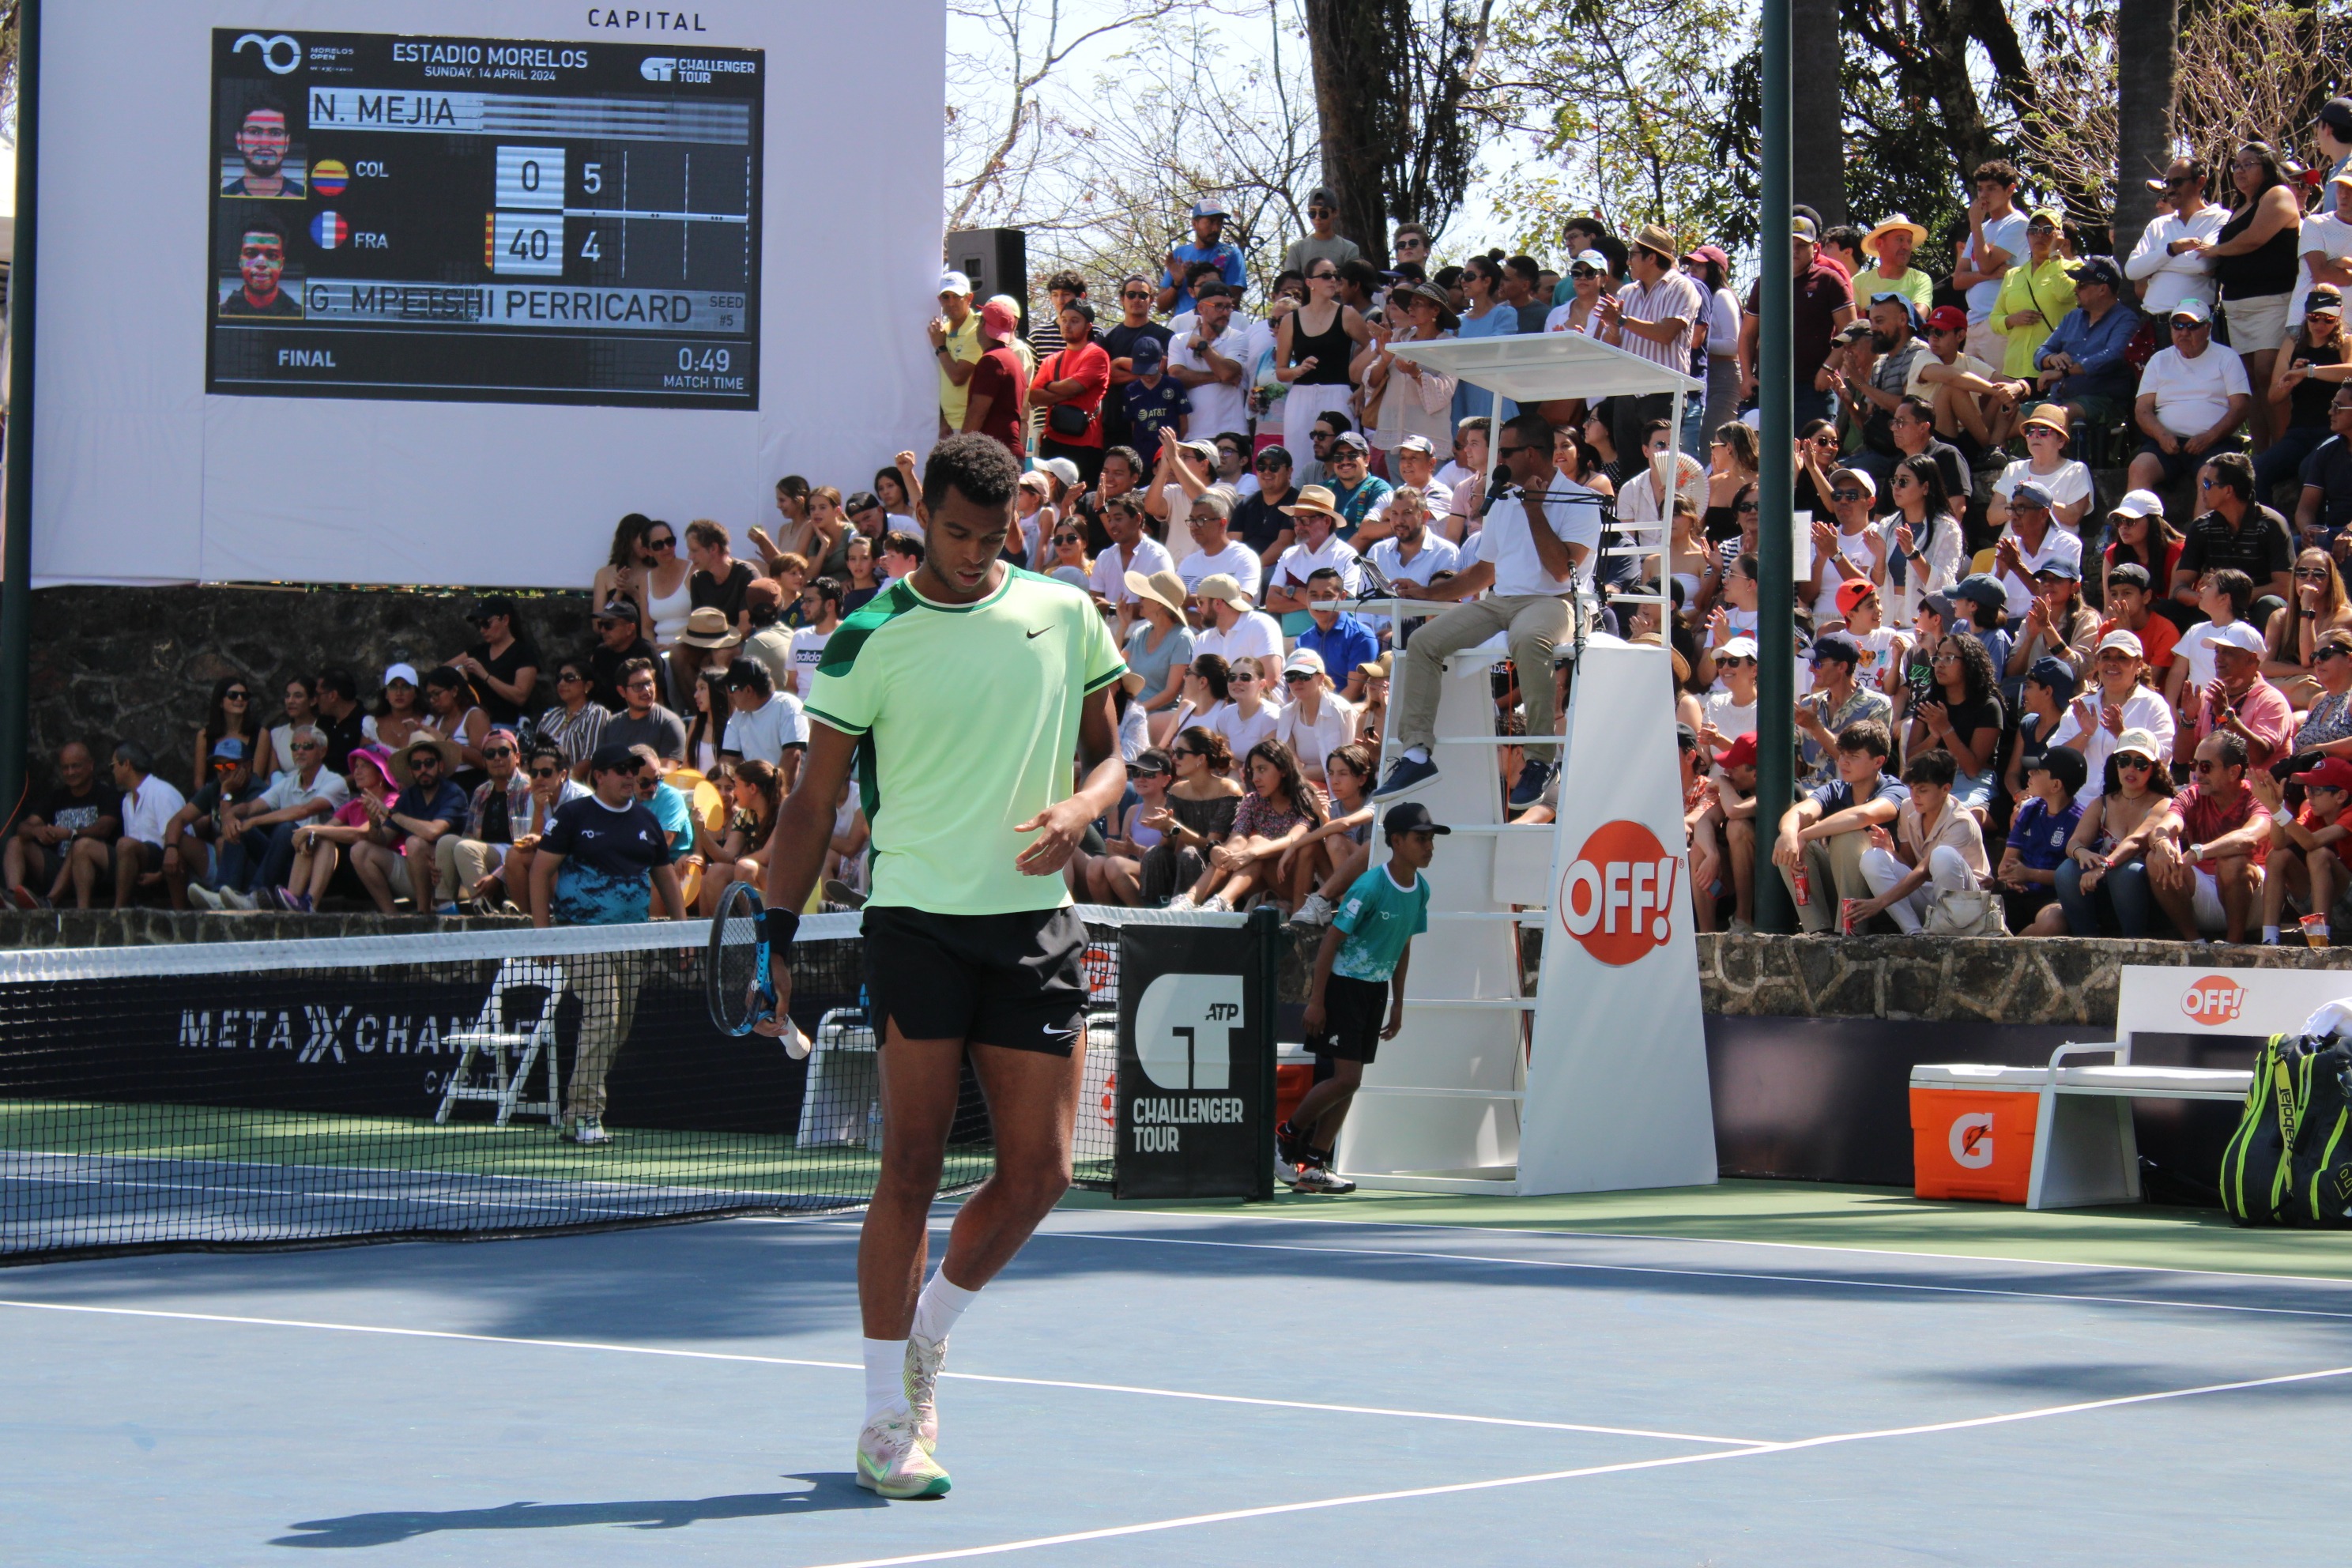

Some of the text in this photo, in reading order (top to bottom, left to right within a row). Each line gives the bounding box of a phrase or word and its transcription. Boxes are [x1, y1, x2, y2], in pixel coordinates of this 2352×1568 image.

[588, 9, 707, 32] CAPITAL
[393, 43, 589, 69] ESTADIO MORELOS
[678, 58, 756, 74] CHALLENGER
[478, 67, 492, 78] 14
[493, 69, 528, 80] APRIL
[530, 70, 556, 81] 2024
[678, 71, 711, 83] TOUR
[314, 93, 456, 126] N. MEJIA
[356, 160, 390, 179] COL
[521, 160, 540, 192] 0
[583, 163, 602, 194] 5
[354, 232, 389, 249] FRA
[508, 228, 548, 262] 40
[581, 231, 601, 262] 4
[309, 284, 338, 313] G.
[506, 290, 692, 324] PERRICARD
[709, 296, 744, 309] SEED
[718, 315, 734, 327] #5
[278, 349, 336, 368] FINAL
[678, 347, 730, 372] 0:49
[664, 375, 744, 390] MATCH TIME
[1148, 408, 1167, 418] AT&T
[796, 651, 822, 662] adida
[1560, 856, 1677, 944] OFF!
[1204, 1003, 1239, 1021] ATP
[2180, 986, 2245, 1020] OFF!
[1133, 1098, 1244, 1124] CHALLENGER
[1133, 1126, 1180, 1152] TOUR
[1948, 1112, 1993, 1170] G
